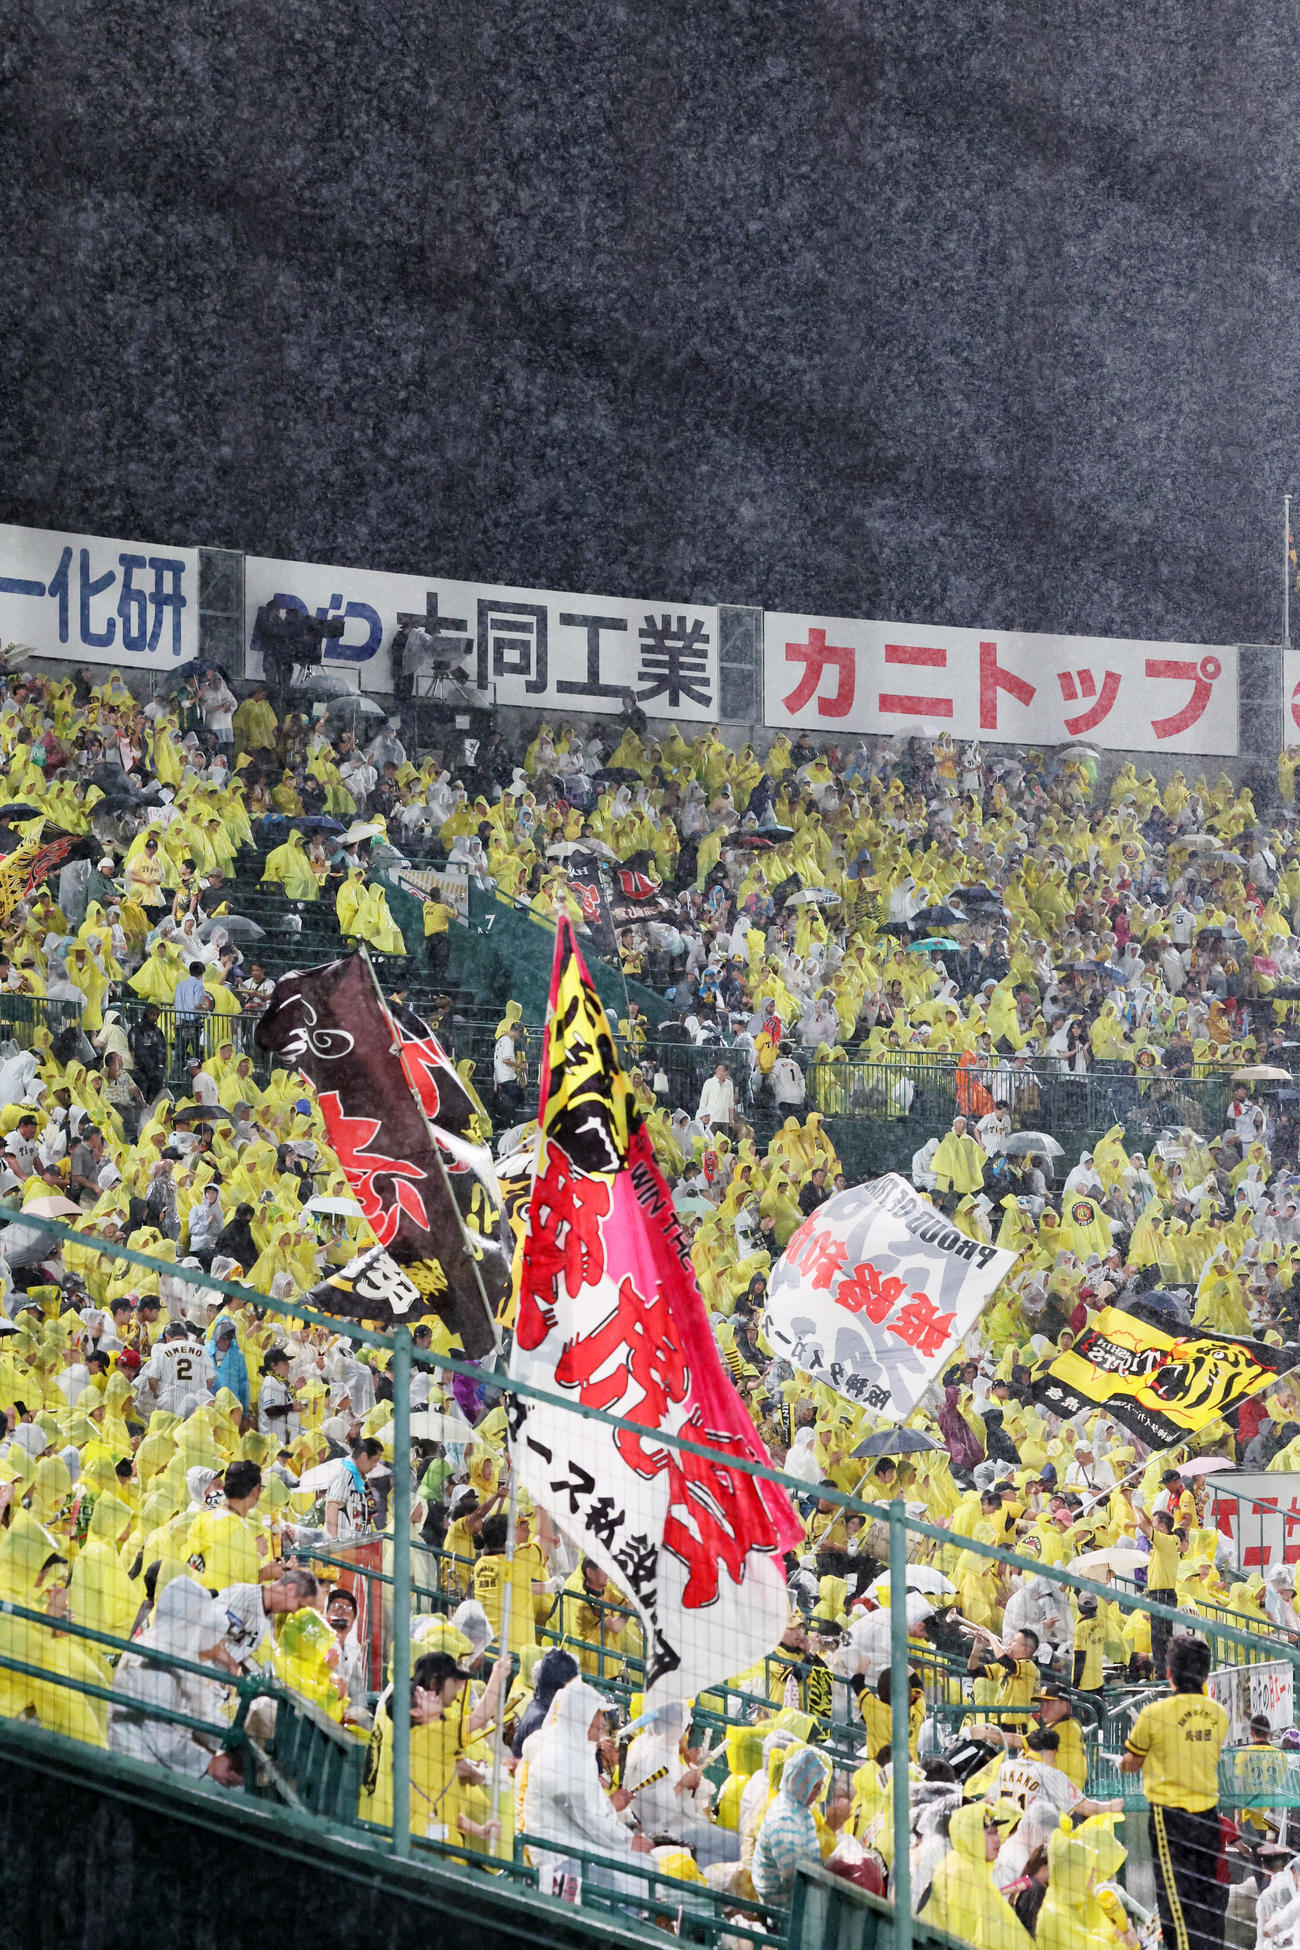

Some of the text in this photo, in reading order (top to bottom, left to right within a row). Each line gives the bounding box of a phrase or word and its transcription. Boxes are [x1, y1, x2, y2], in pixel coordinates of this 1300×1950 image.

[781, 627, 1222, 739] カニトップ
[484, 914, 496, 930] 7
[1176, 915, 1184, 924] 5
[790, 1068, 795, 1082] 1
[629, 1161, 667, 1217] WIN
[165, 1346, 203, 1358] UMENO
[177, 1358, 193, 1380] 2
[1000, 1768, 1040, 1792] AKANO
